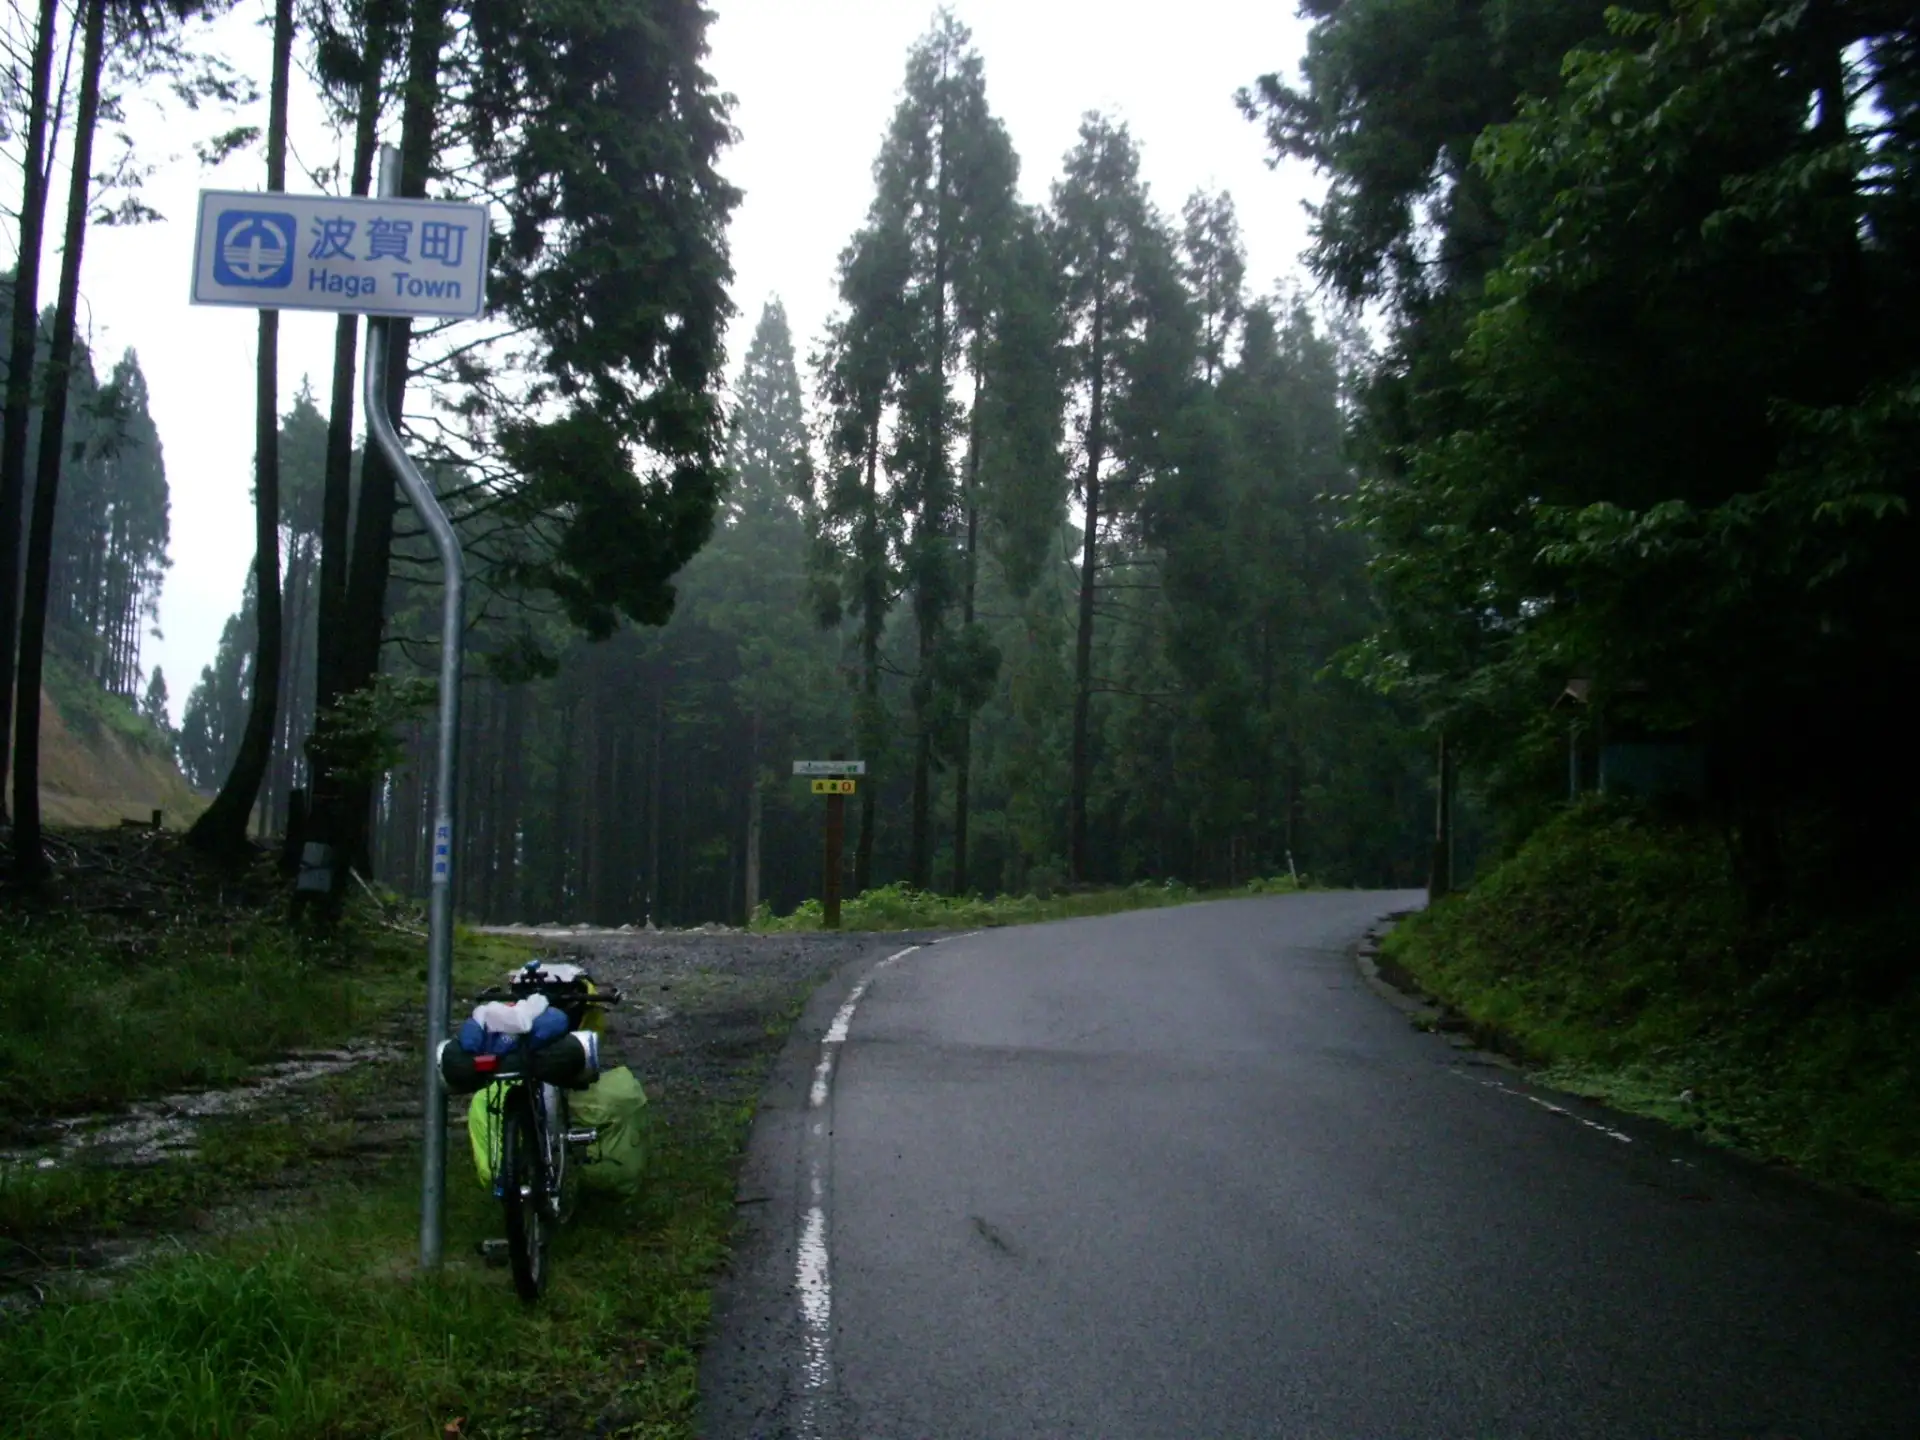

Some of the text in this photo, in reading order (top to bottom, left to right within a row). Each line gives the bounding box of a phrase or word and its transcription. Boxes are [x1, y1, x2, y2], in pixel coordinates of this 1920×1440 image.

[307, 215, 469, 267] 波賀町
[308, 268, 462, 299] Haga Town
